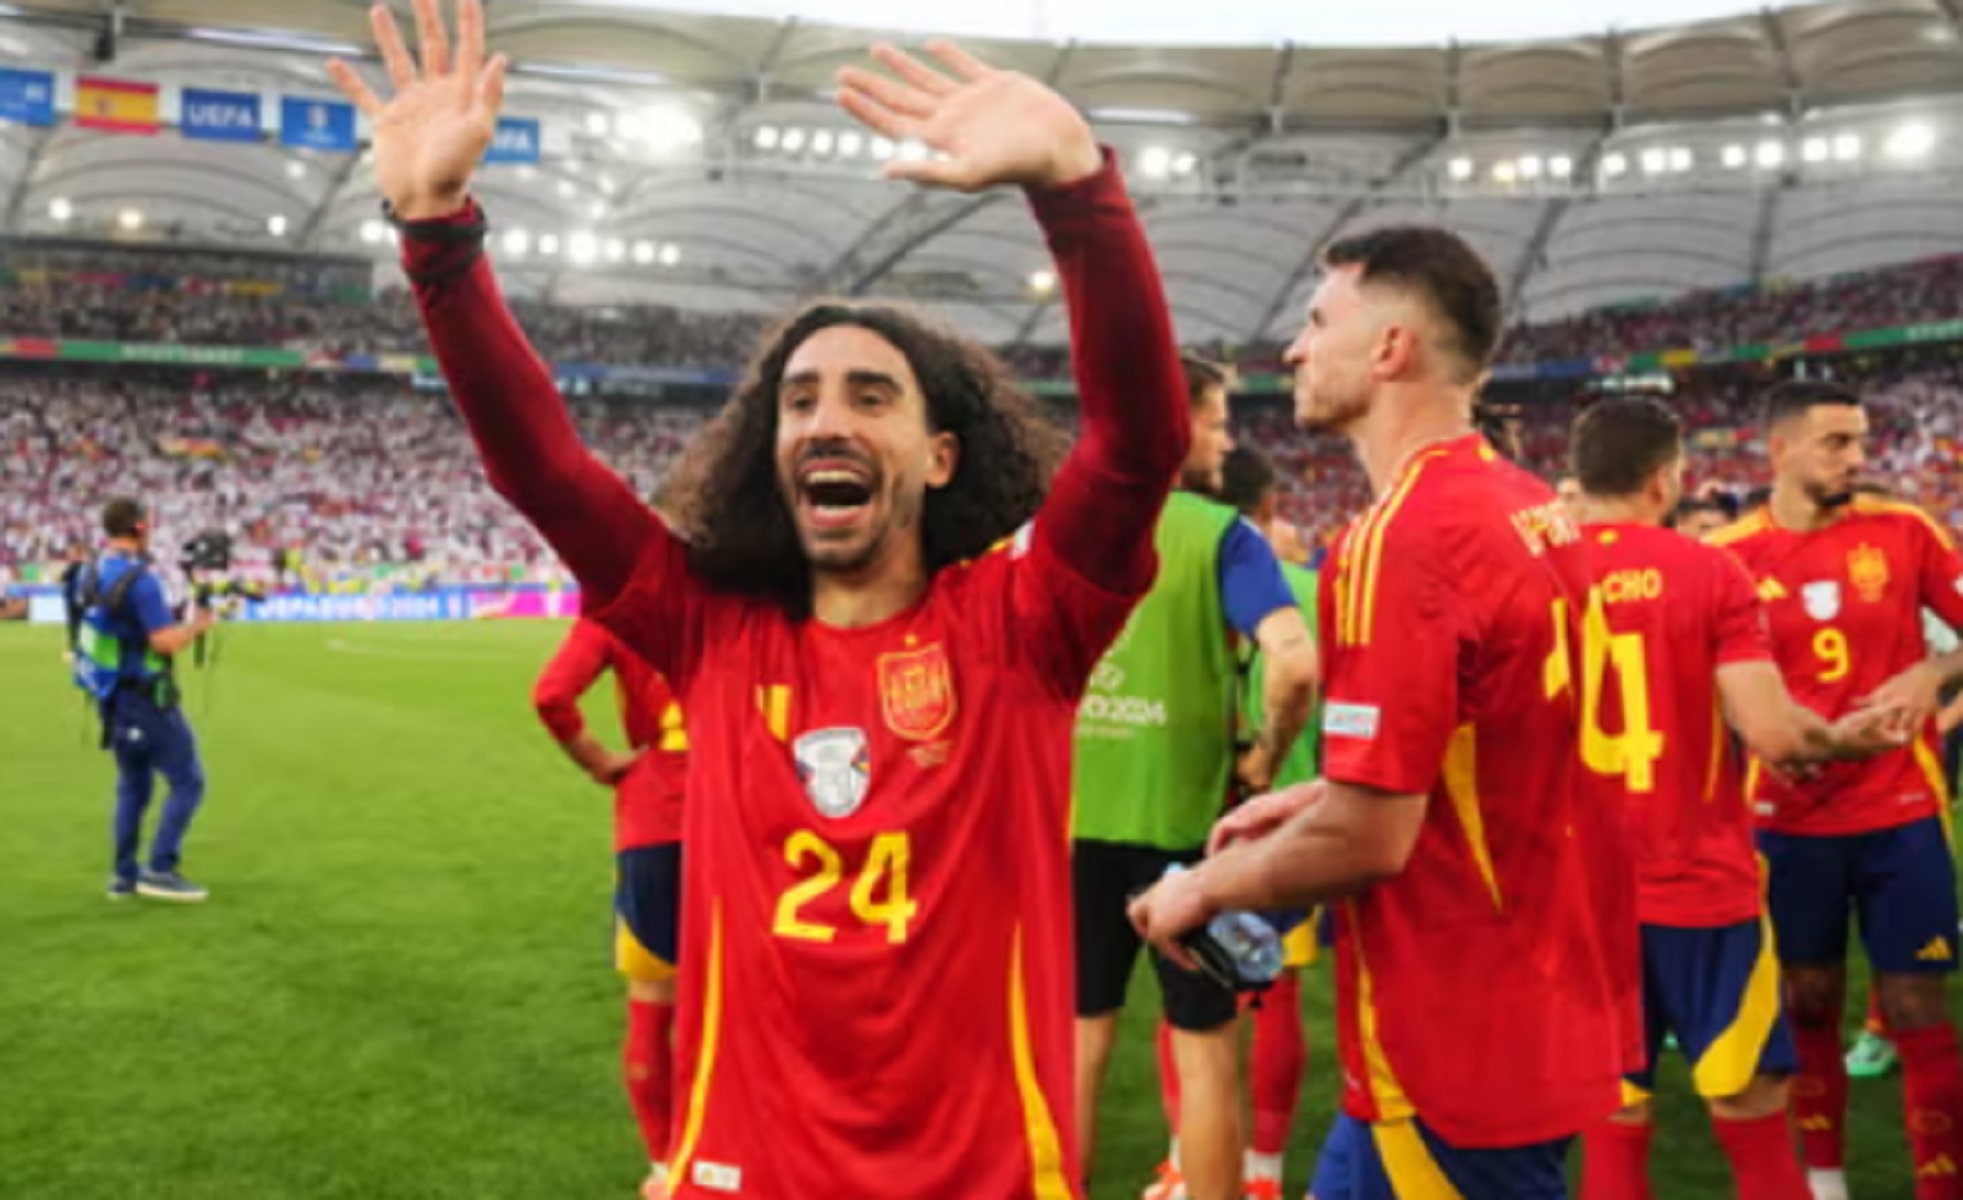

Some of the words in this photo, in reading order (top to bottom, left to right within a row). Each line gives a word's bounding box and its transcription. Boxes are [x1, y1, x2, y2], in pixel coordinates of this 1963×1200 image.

[189, 103, 253, 127] UEFA
[1602, 567, 1662, 603] CHO
[1813, 628, 1849, 681] 9
[773, 829, 917, 944] 24
